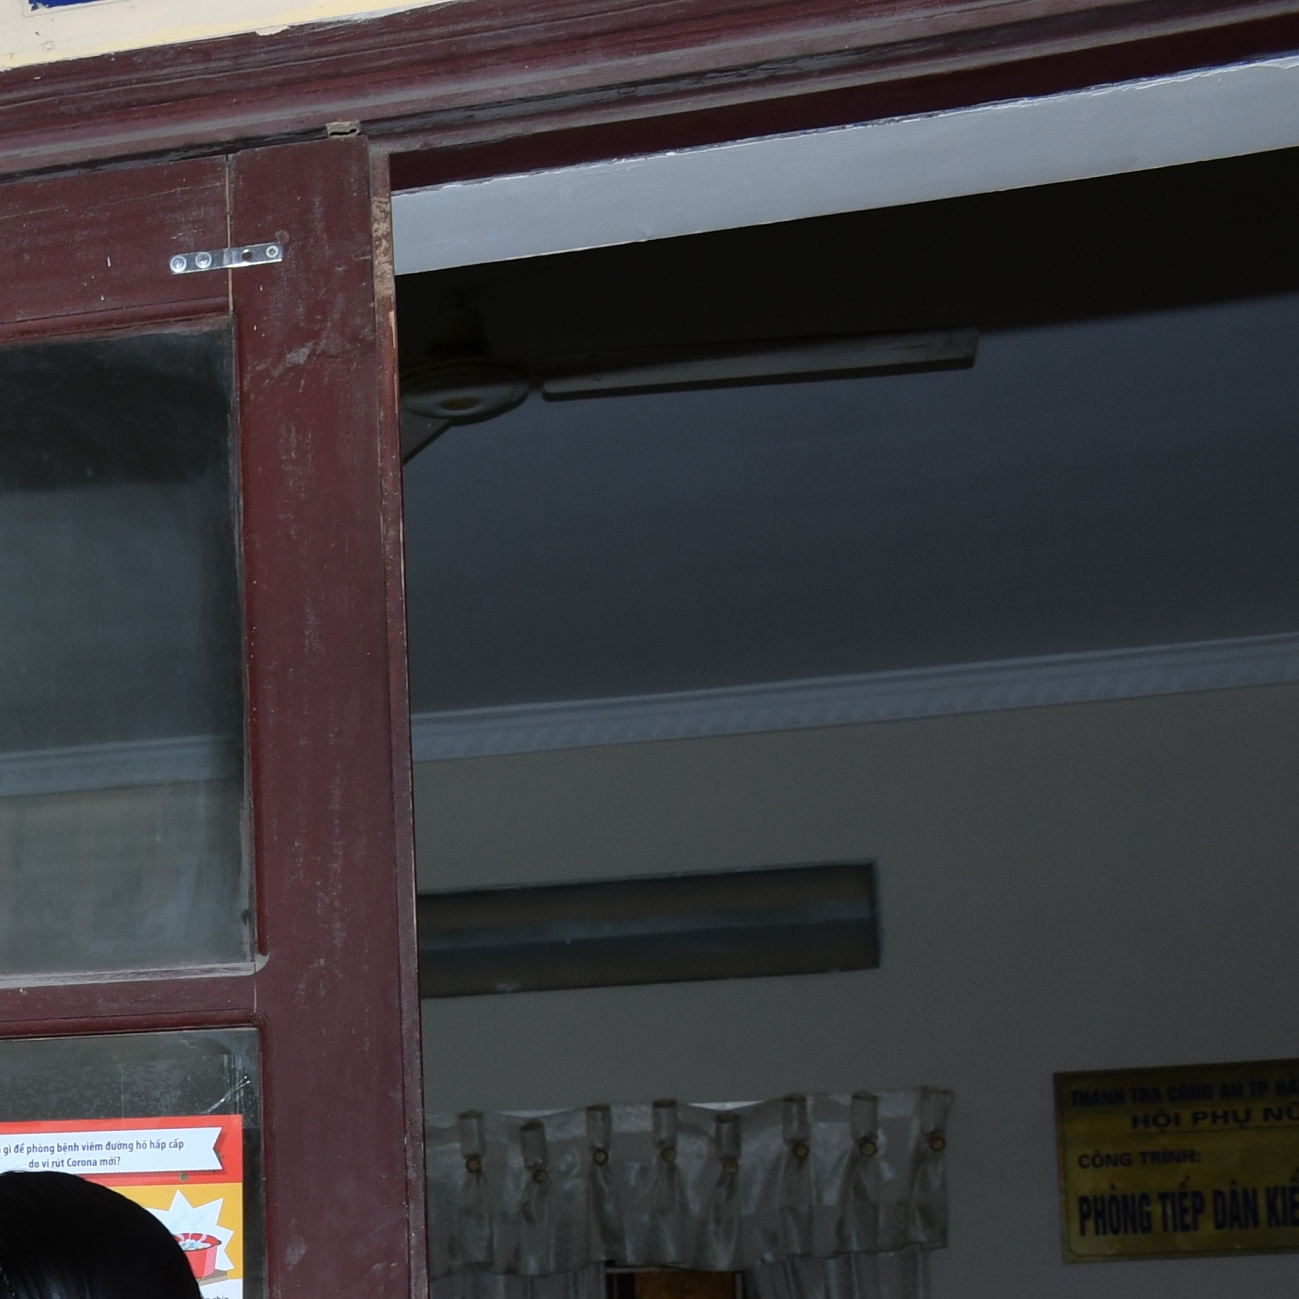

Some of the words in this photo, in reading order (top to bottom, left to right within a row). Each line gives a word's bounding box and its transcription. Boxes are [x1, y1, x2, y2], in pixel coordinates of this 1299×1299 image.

[1132, 1107, 1181, 1134] HỘI
[3, 1145, 11, 1157] gì
[27, 1144, 54, 1157] phòng
[57, 1143, 79, 1155] bệnh
[81, 1142, 103, 1152] viêm
[105, 1140, 133, 1153] đường
[136, 1140, 147, 1150] hô
[150, 1139, 166, 1151] hấp
[168, 1138, 184, 1151] cấp
[28, 1159, 40, 1169] do
[42, 1159, 49, 1168] vi
[52, 1158, 64, 1168] rút
[67, 1157, 97, 1168] Corona
[99, 1156, 121, 1167] mới?
[1078, 1149, 1132, 1169] CÔNG
[1078, 1184, 1152, 1236] PHÒNG
[1158, 1173, 1205, 1233] TIẾP
[1212, 1179, 1259, 1231] DÂN
